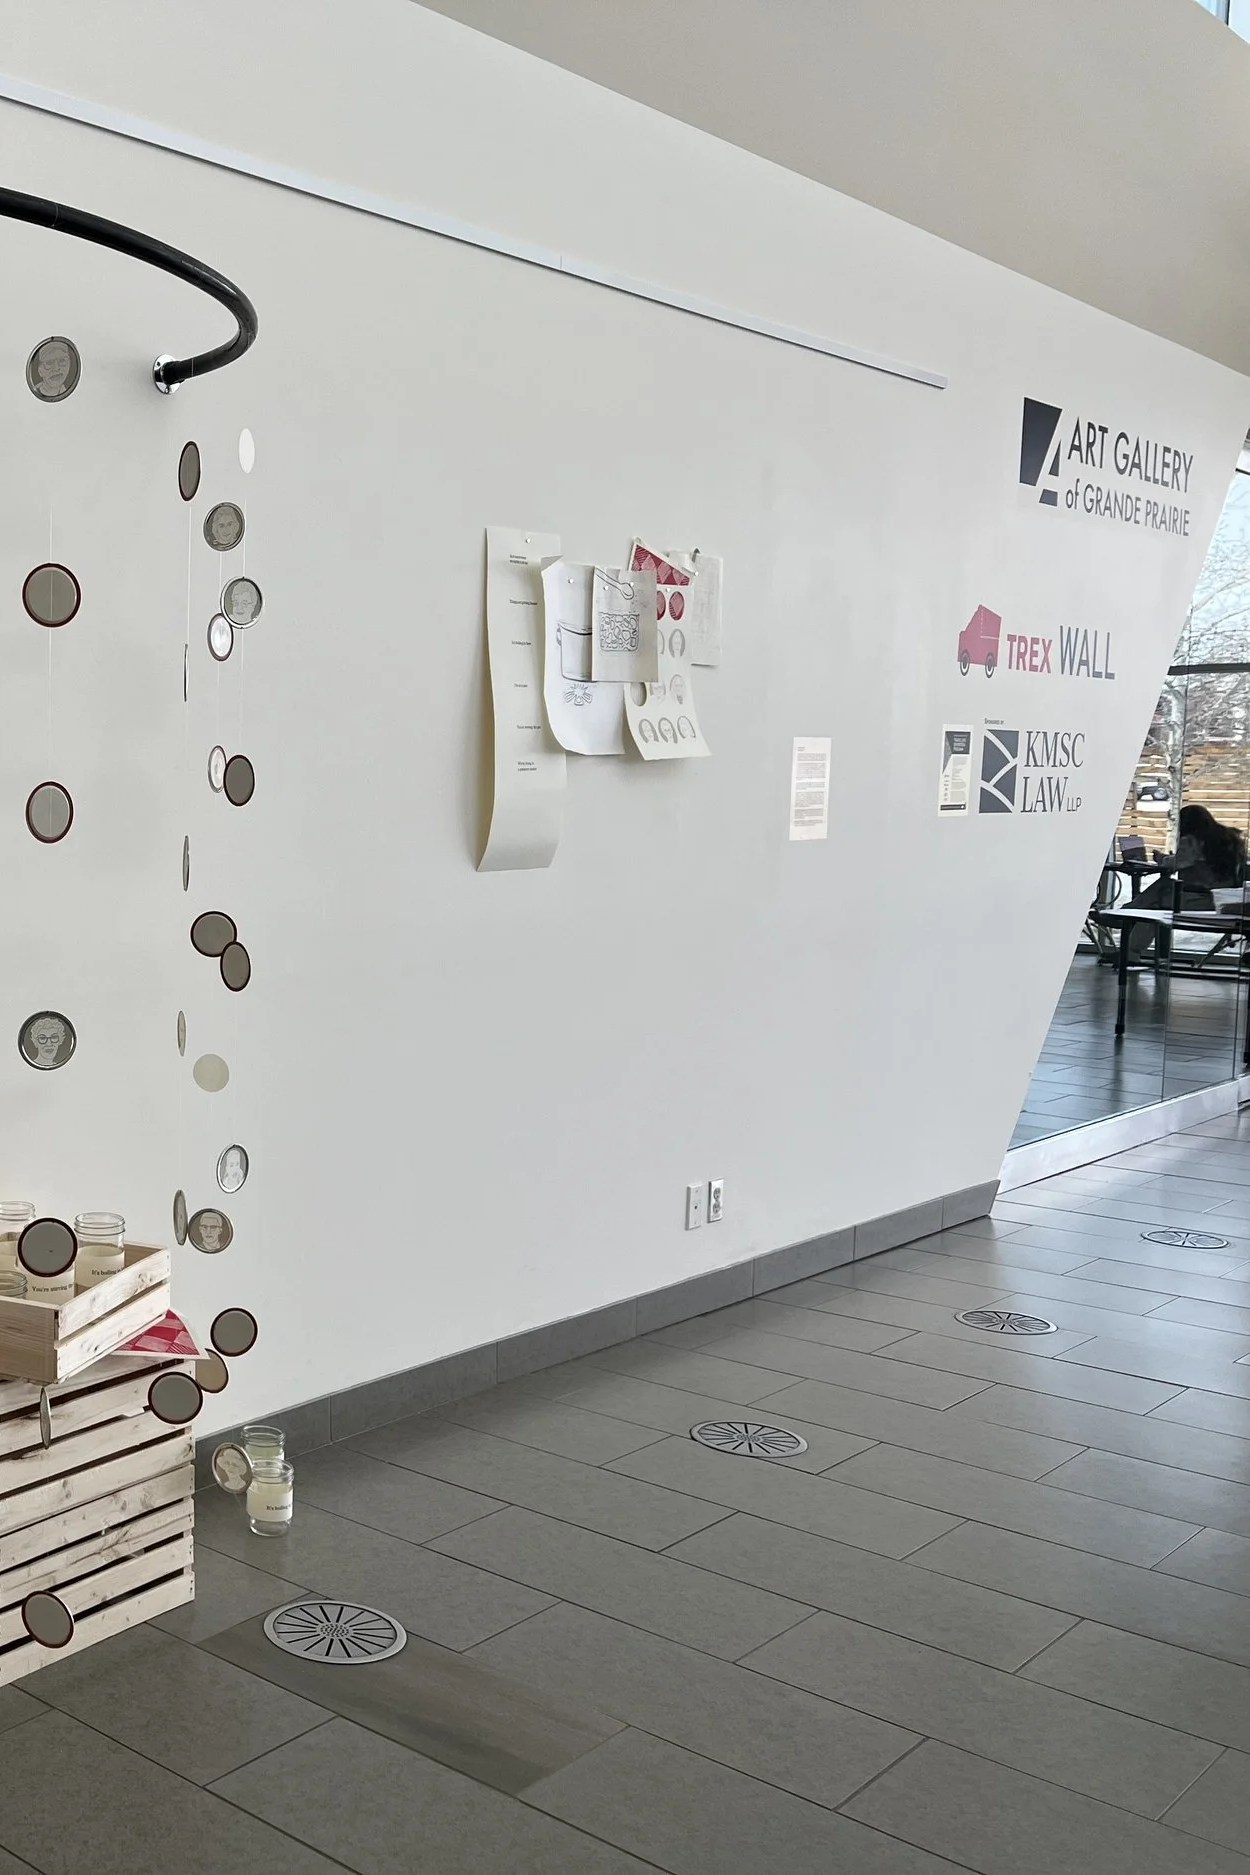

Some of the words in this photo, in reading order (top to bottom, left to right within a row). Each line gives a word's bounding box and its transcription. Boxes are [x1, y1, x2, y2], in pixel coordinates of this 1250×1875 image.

[1067, 416, 1109, 469] ART
[1114, 431, 1194, 493] GALLERY
[1065, 478, 1080, 509] of
[1083, 483, 1141, 524] GRANDE
[1144, 499, 1190, 537] PRAIRIE
[1007, 633, 1052, 674] TREX
[1060, 625, 1115, 680] WALL
[1023, 730, 1085, 768] KMSC
[1020, 776, 1068, 813] LAW
[1066, 797, 1082, 812] LLP
